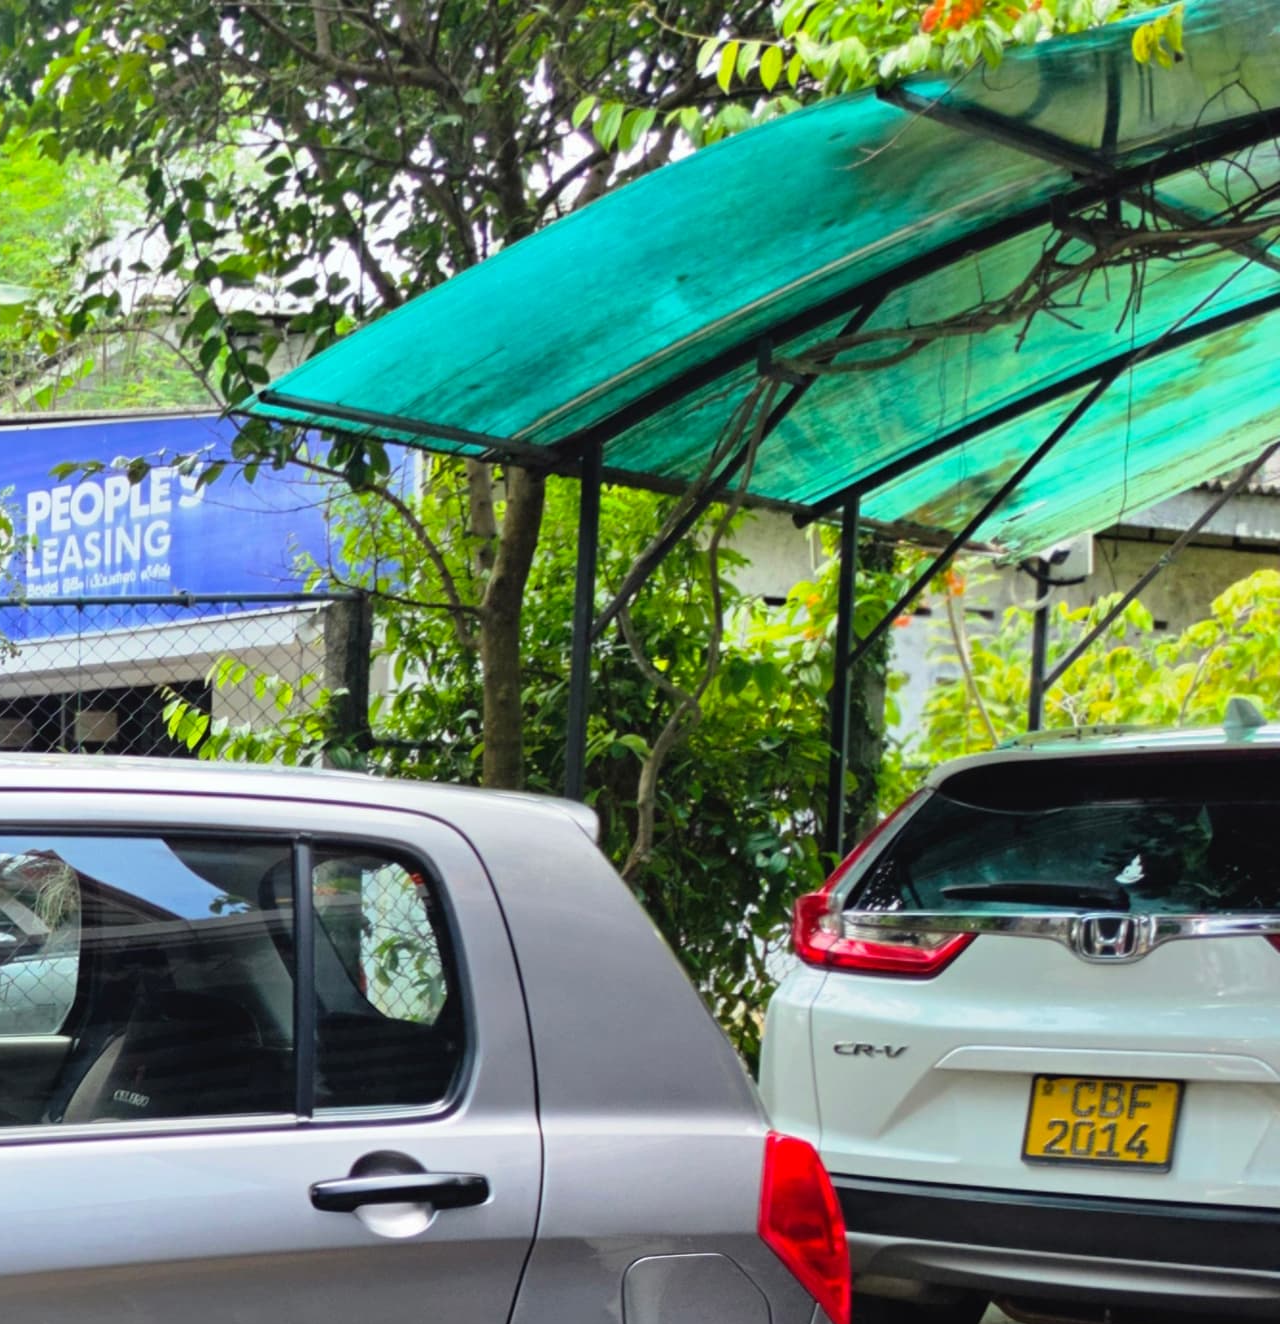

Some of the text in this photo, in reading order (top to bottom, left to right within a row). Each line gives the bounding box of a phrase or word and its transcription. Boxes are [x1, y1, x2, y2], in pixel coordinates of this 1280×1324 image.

[26, 520, 172, 578] LEASING
[833, 1043, 909, 1059] CR-V
[1071, 1081, 1158, 1119] CBF
[1043, 1119, 1150, 1160] 2014
